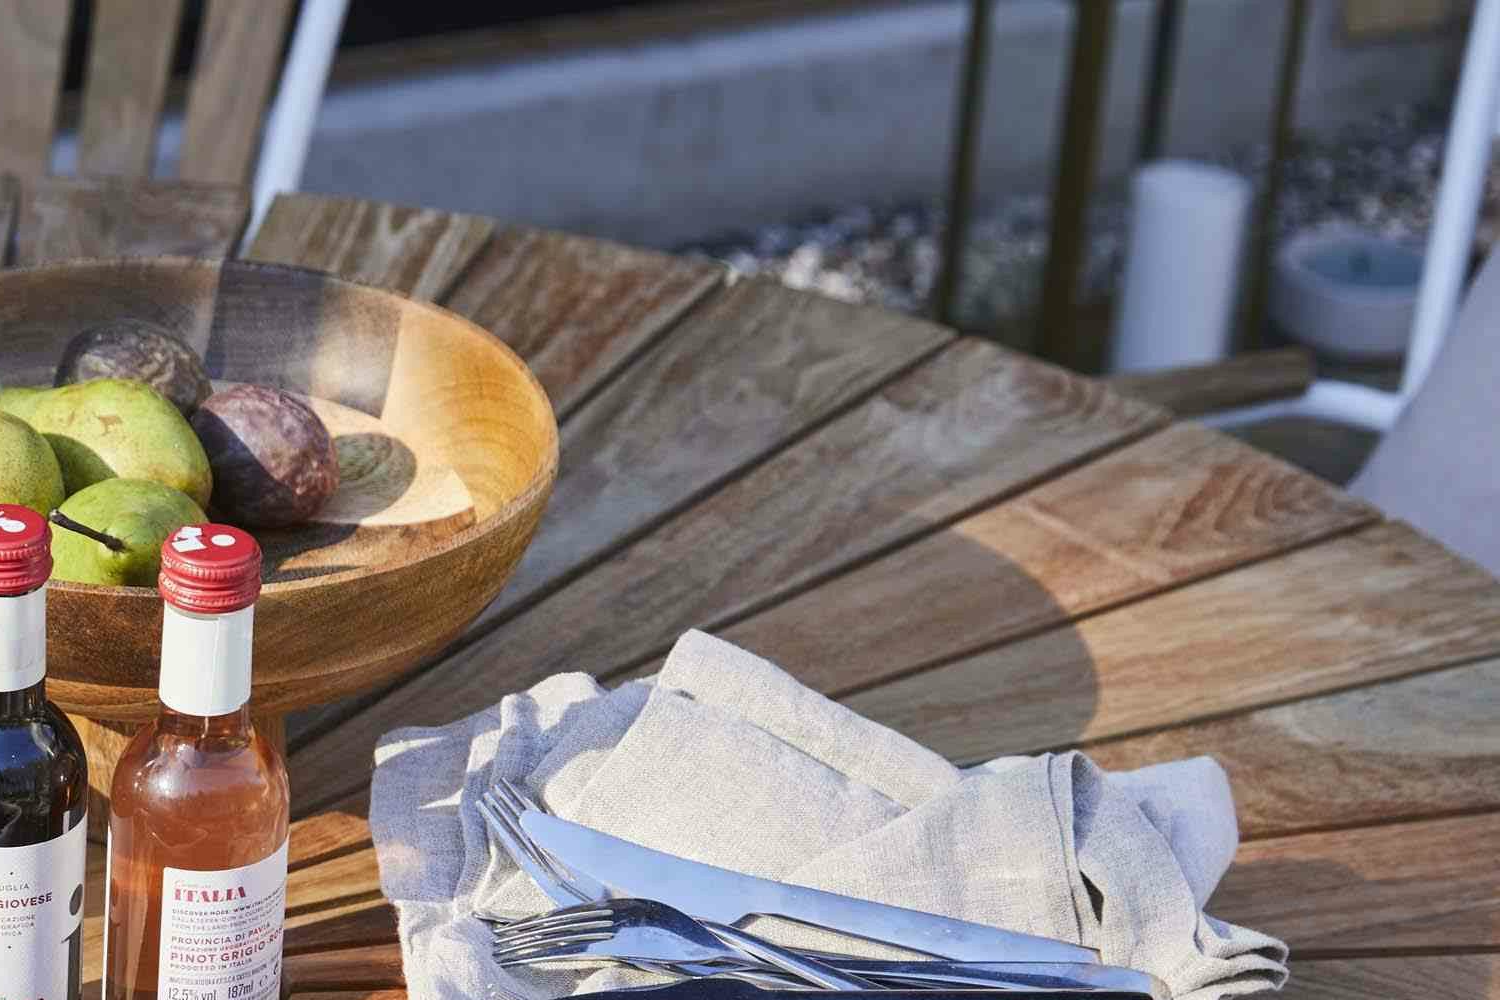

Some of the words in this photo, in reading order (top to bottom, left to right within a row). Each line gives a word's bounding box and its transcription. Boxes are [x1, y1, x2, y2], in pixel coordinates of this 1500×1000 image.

[174, 886, 246, 903] ITALIA
[171, 935, 232, 946] PROVINCIA
[235, 932, 245, 942] DI
[248, 922, 271, 937] PAVIA
[170, 952, 217, 964] PINOT
[220, 941, 266, 962] GRIGIO
[229, 958, 253, 968] ITALIA
[228, 981, 254, 999] 187ml
